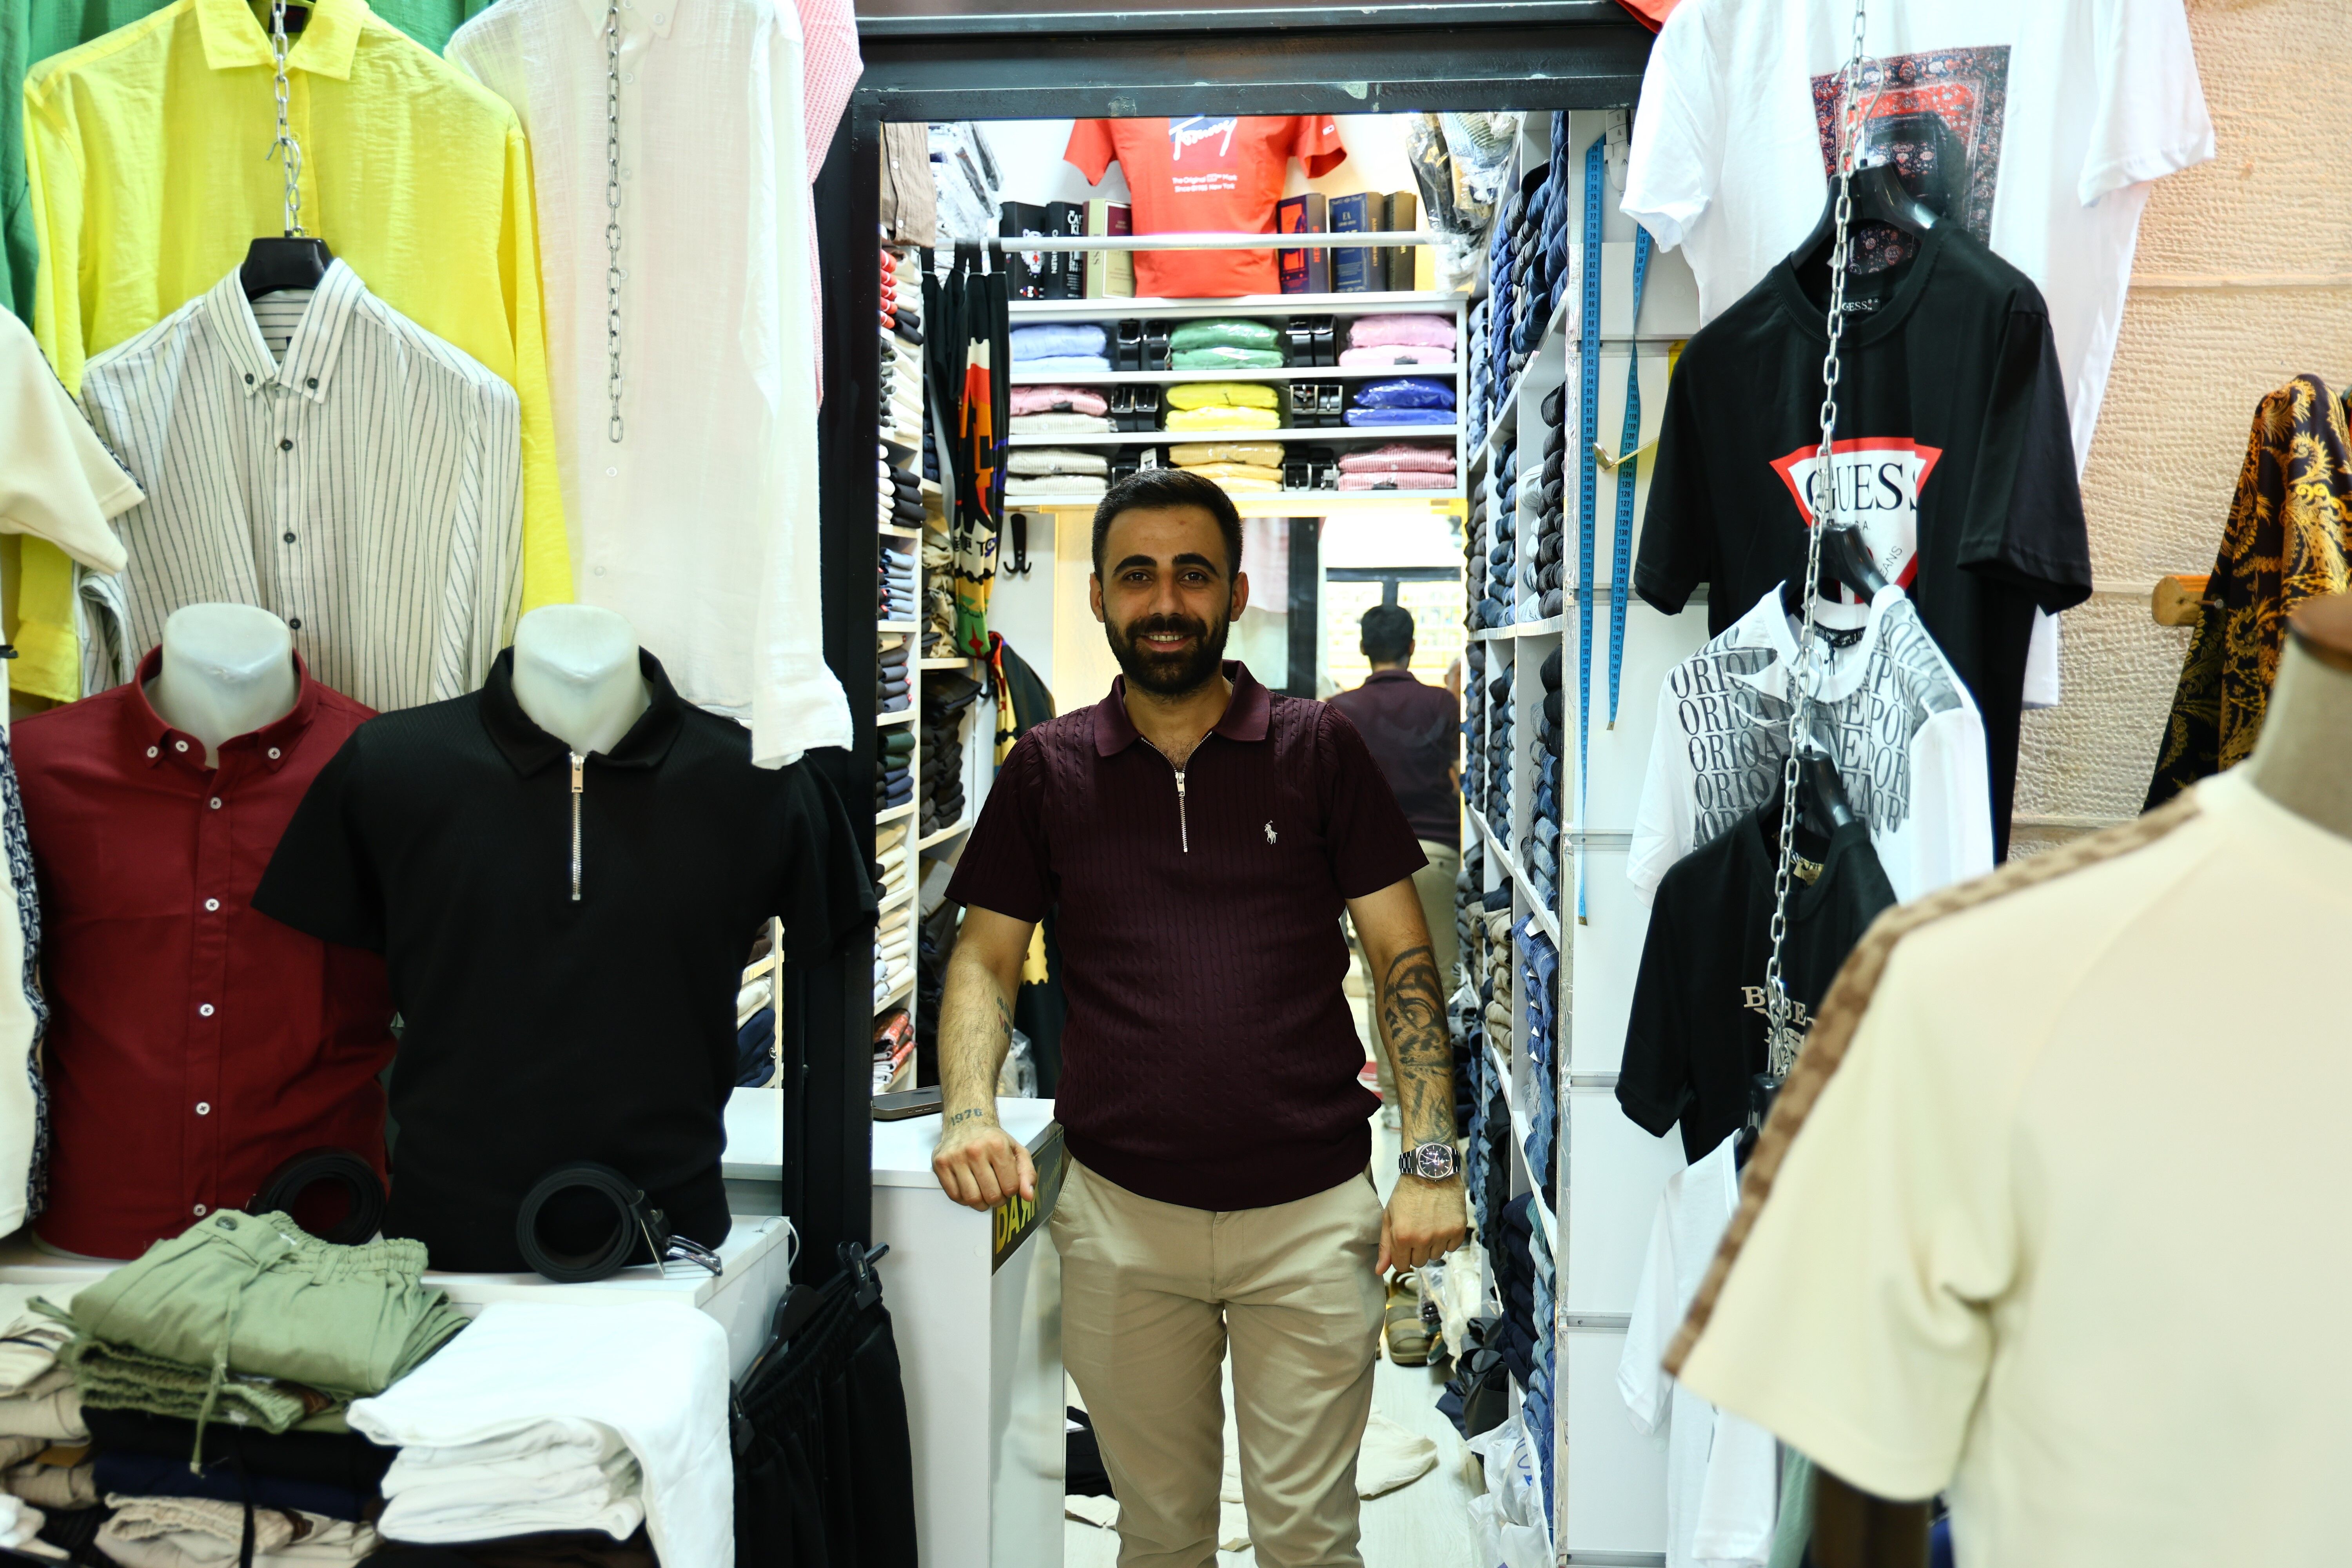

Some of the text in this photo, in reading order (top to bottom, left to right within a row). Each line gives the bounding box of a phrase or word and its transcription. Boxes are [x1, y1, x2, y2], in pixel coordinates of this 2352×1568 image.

[1806, 463, 1918, 513] GUES
[1880, 546, 1902, 578] EANS
[950, 1108, 983, 1127] 1976
